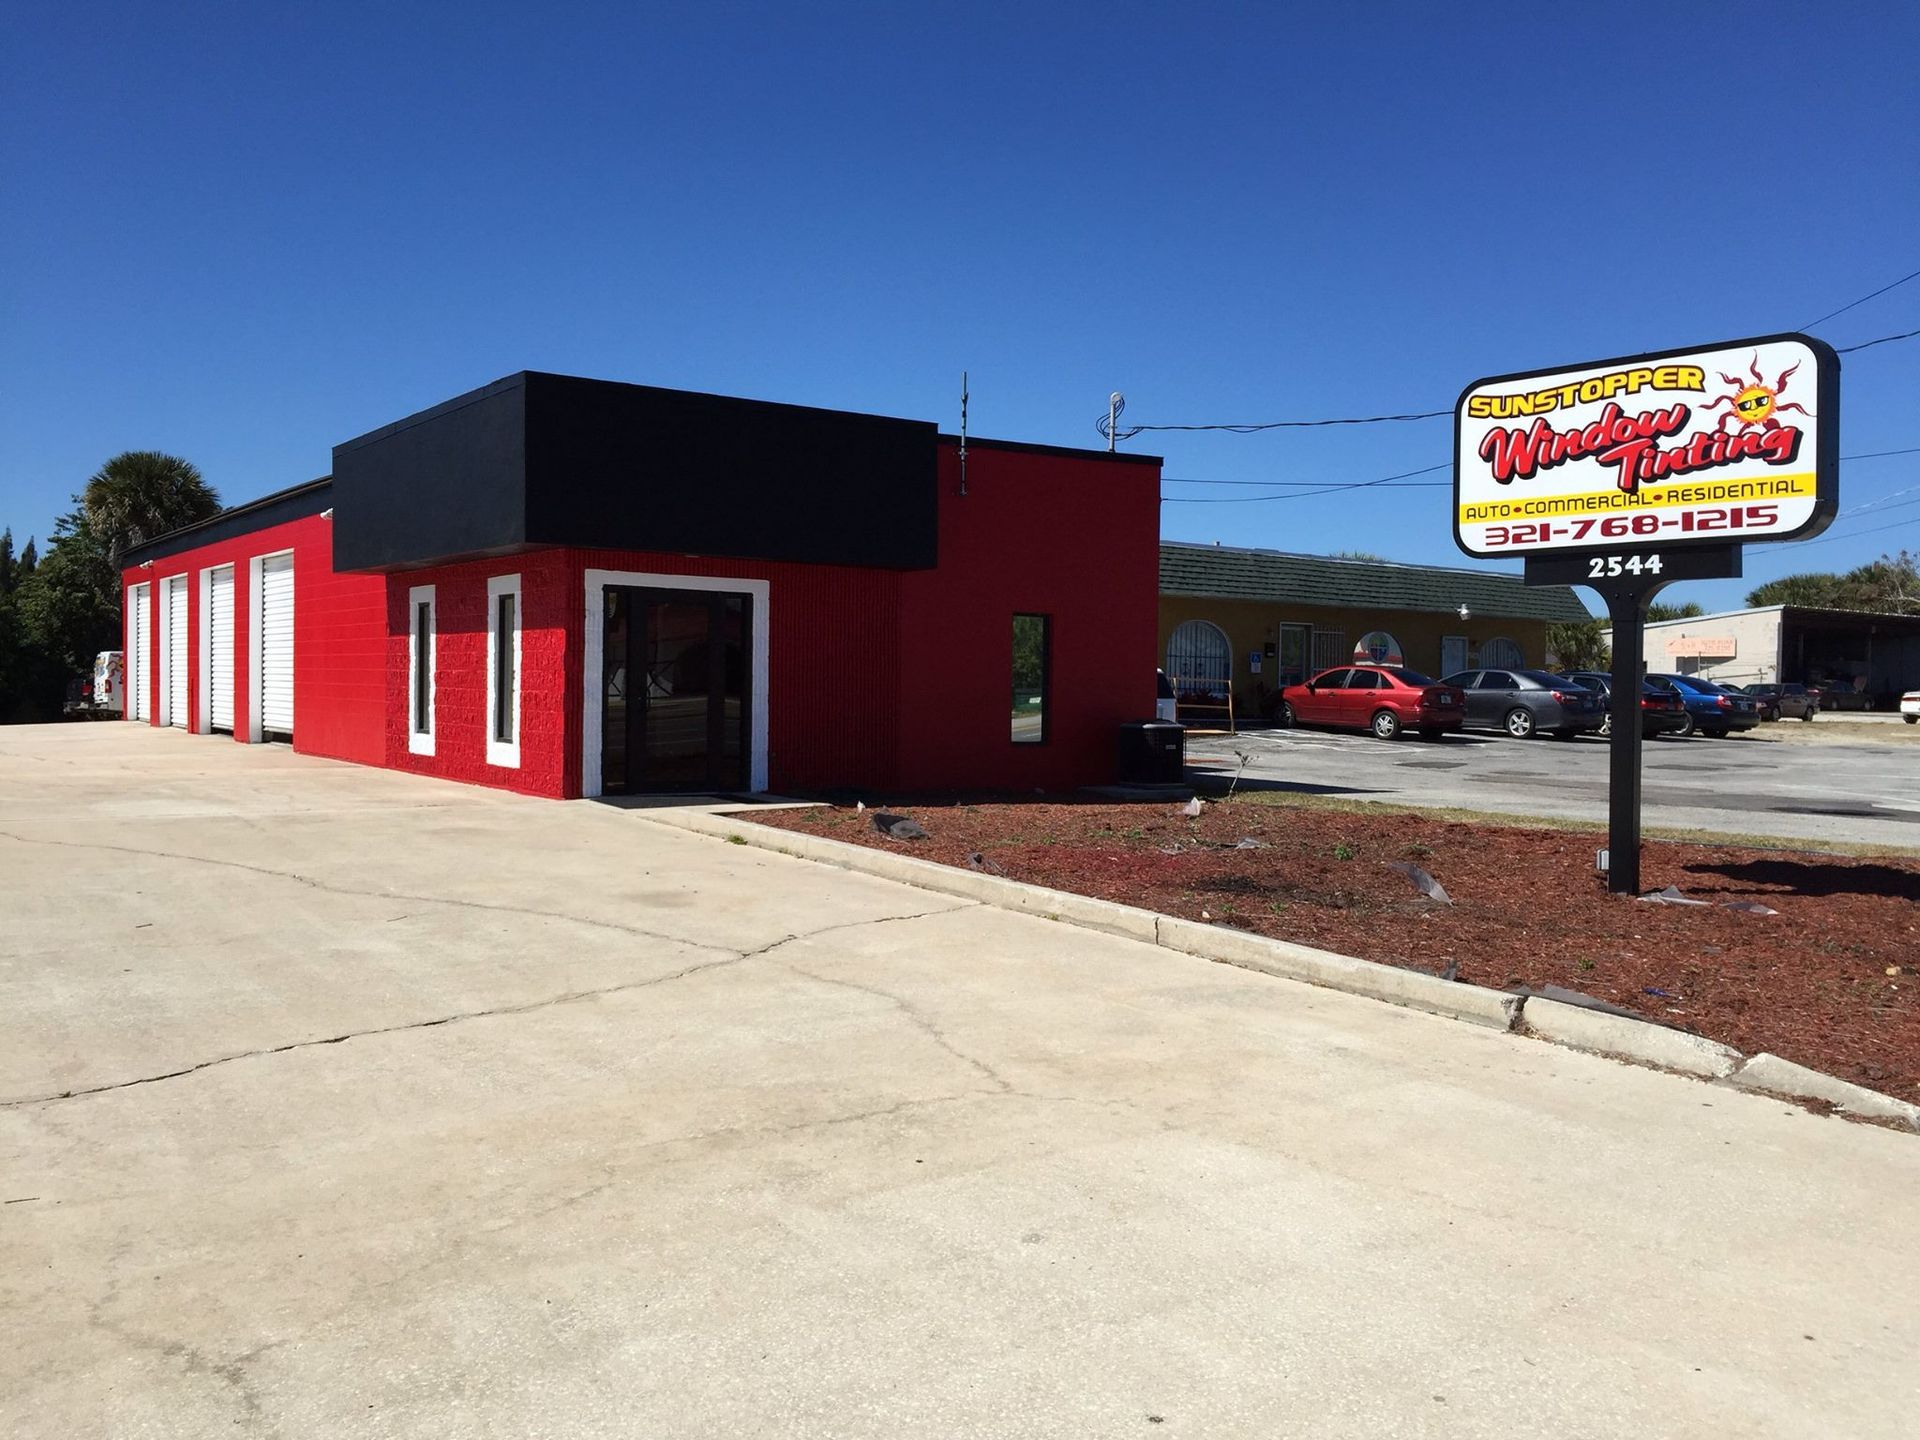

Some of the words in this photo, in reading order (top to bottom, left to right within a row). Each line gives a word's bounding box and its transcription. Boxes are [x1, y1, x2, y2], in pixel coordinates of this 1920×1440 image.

[1468, 365, 1706, 418] SUNSTOPPER
[1479, 402, 1691, 483] Window
[1596, 425, 1803, 492] Tinting
[1466, 504, 1510, 519] AUTO
[1524, 493, 1653, 514] COMMERCIAL
[1667, 480, 1804, 503] RESIDENTIAL
[1485, 505, 1778, 546] 321-768-1215
[1588, 554, 1663, 578] 2544
